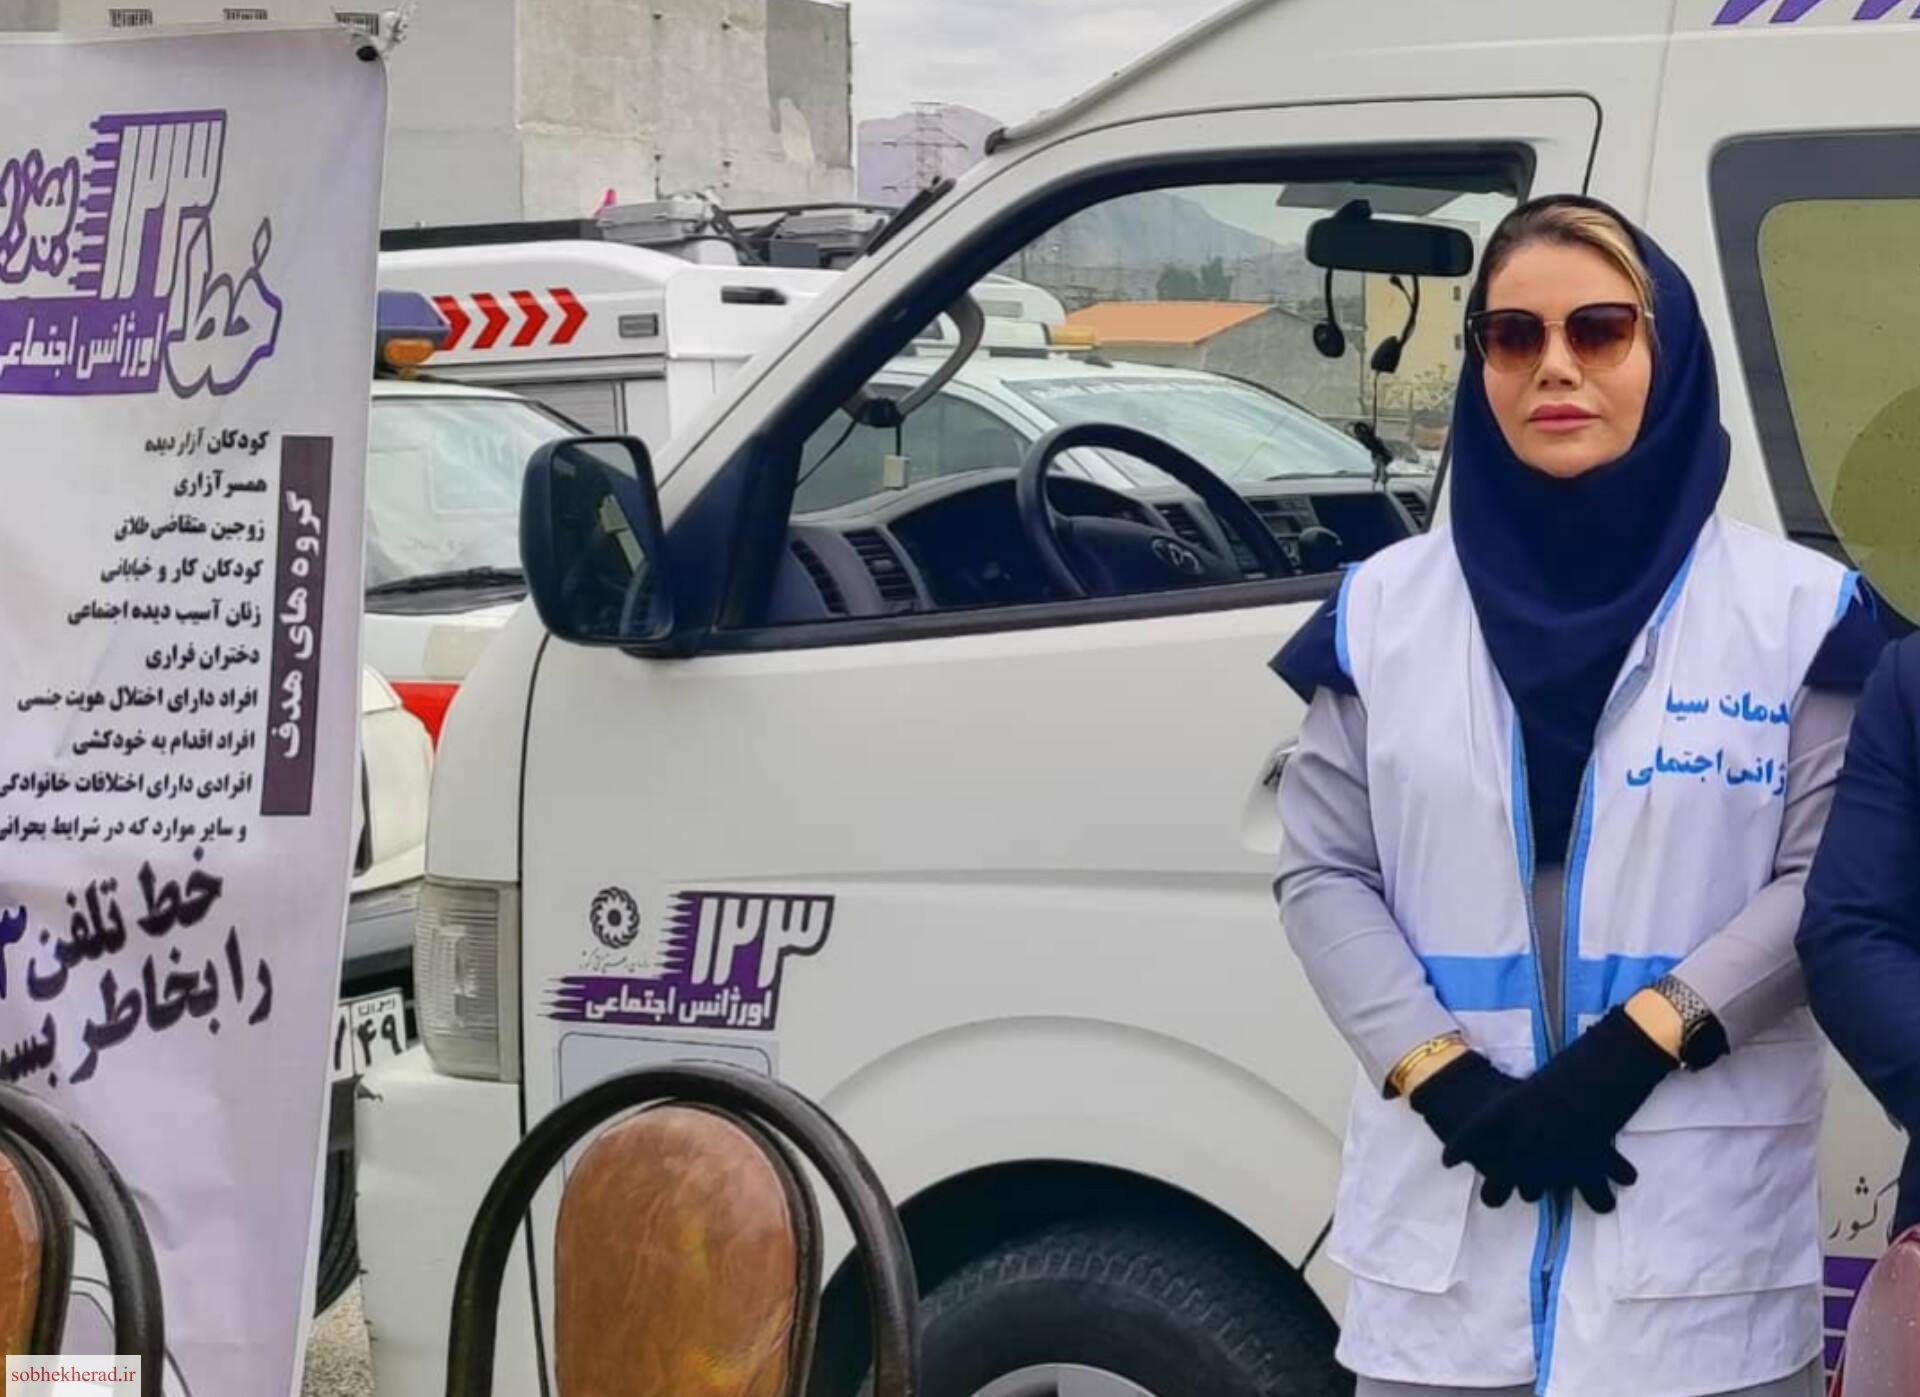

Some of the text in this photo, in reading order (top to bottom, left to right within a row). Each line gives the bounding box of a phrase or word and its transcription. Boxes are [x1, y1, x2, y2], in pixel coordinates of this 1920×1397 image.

[77, 309, 164, 379] اورژانس
[144, 426, 271, 457] کودکان آزار دیده
[173, 468, 268, 499] همسر آزاری
[113, 513, 266, 543] زوجین متقاضی طلاق
[99, 555, 265, 586] کودکان کار و خیابانی
[66, 597, 262, 629] زنان آسیب دیده اجتماعی
[271, 490, 321, 758] گروه های هدف
[144, 641, 261, 672] دختران فراری
[16, 685, 259, 715] افراد دارای اختلال هویت جنسی
[1665, 683, 1792, 726] دمات سیا
[71, 728, 256, 758] افراد اقدام به خودکشی
[73, 770, 145, 794] اختلافات
[145, 772, 195, 800] دارای
[195, 770, 254, 800] افرادی
[1726, 756, 1786, 795] ژانس
[51, 814, 101, 843] شرایط
[102, 820, 126, 843] در
[127, 815, 150, 836] که
[152, 816, 197, 843] موارد
[200, 815, 235, 843] سایر
[236, 824, 248, 844] و
[136, 846, 223, 937] خط
[26, 876, 127, 1001] تلفن
[690, 898, 828, 988] ۱۲۳
[225, 925, 273, 1026] را
[68, 946, 219, 1084] بخاطر
[585, 984, 772, 1027] اورژانس اجتماعی
